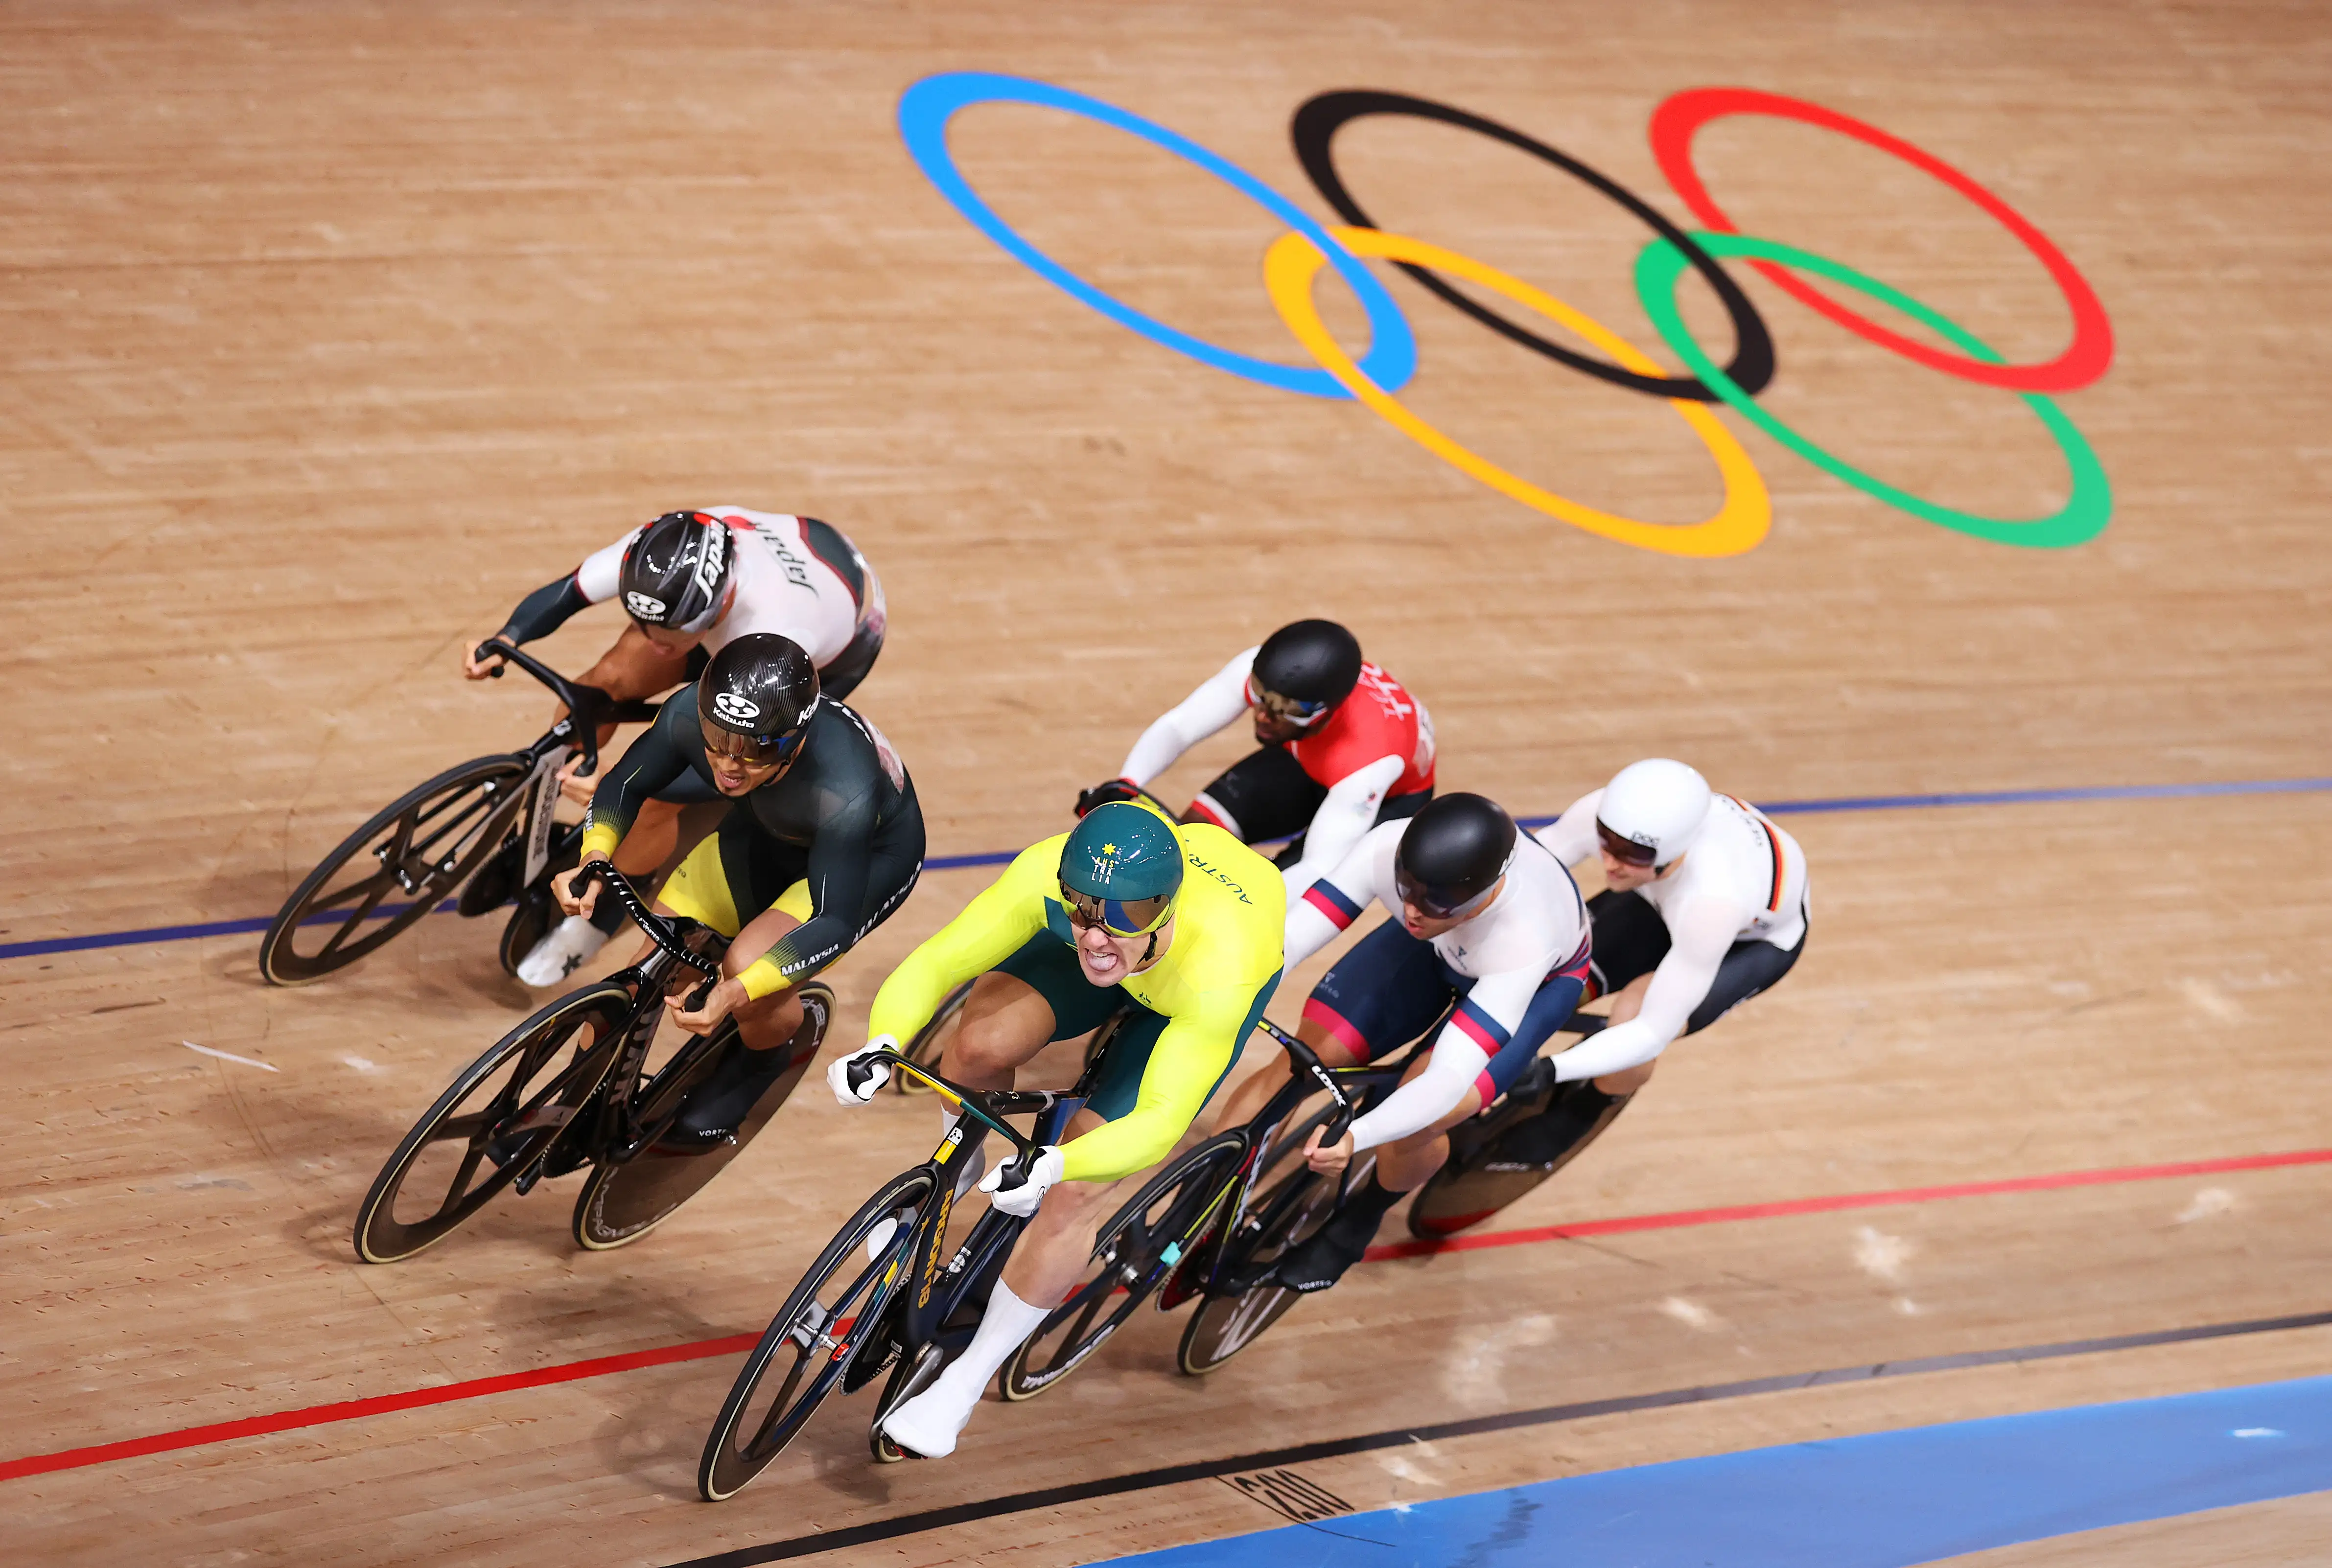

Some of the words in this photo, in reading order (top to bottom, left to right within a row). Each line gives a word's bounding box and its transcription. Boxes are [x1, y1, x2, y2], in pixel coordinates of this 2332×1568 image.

[713, 707, 755, 728] Kabuto
[1092, 872, 1110, 884] LIA
[1096, 856, 1115, 868] AUS
[781, 944, 839, 976] MALAYSIA
[1311, 1065, 1347, 1107] LOOK
[924, 1188, 954, 1280] ARGON
[918, 1276, 932, 1309] 18
